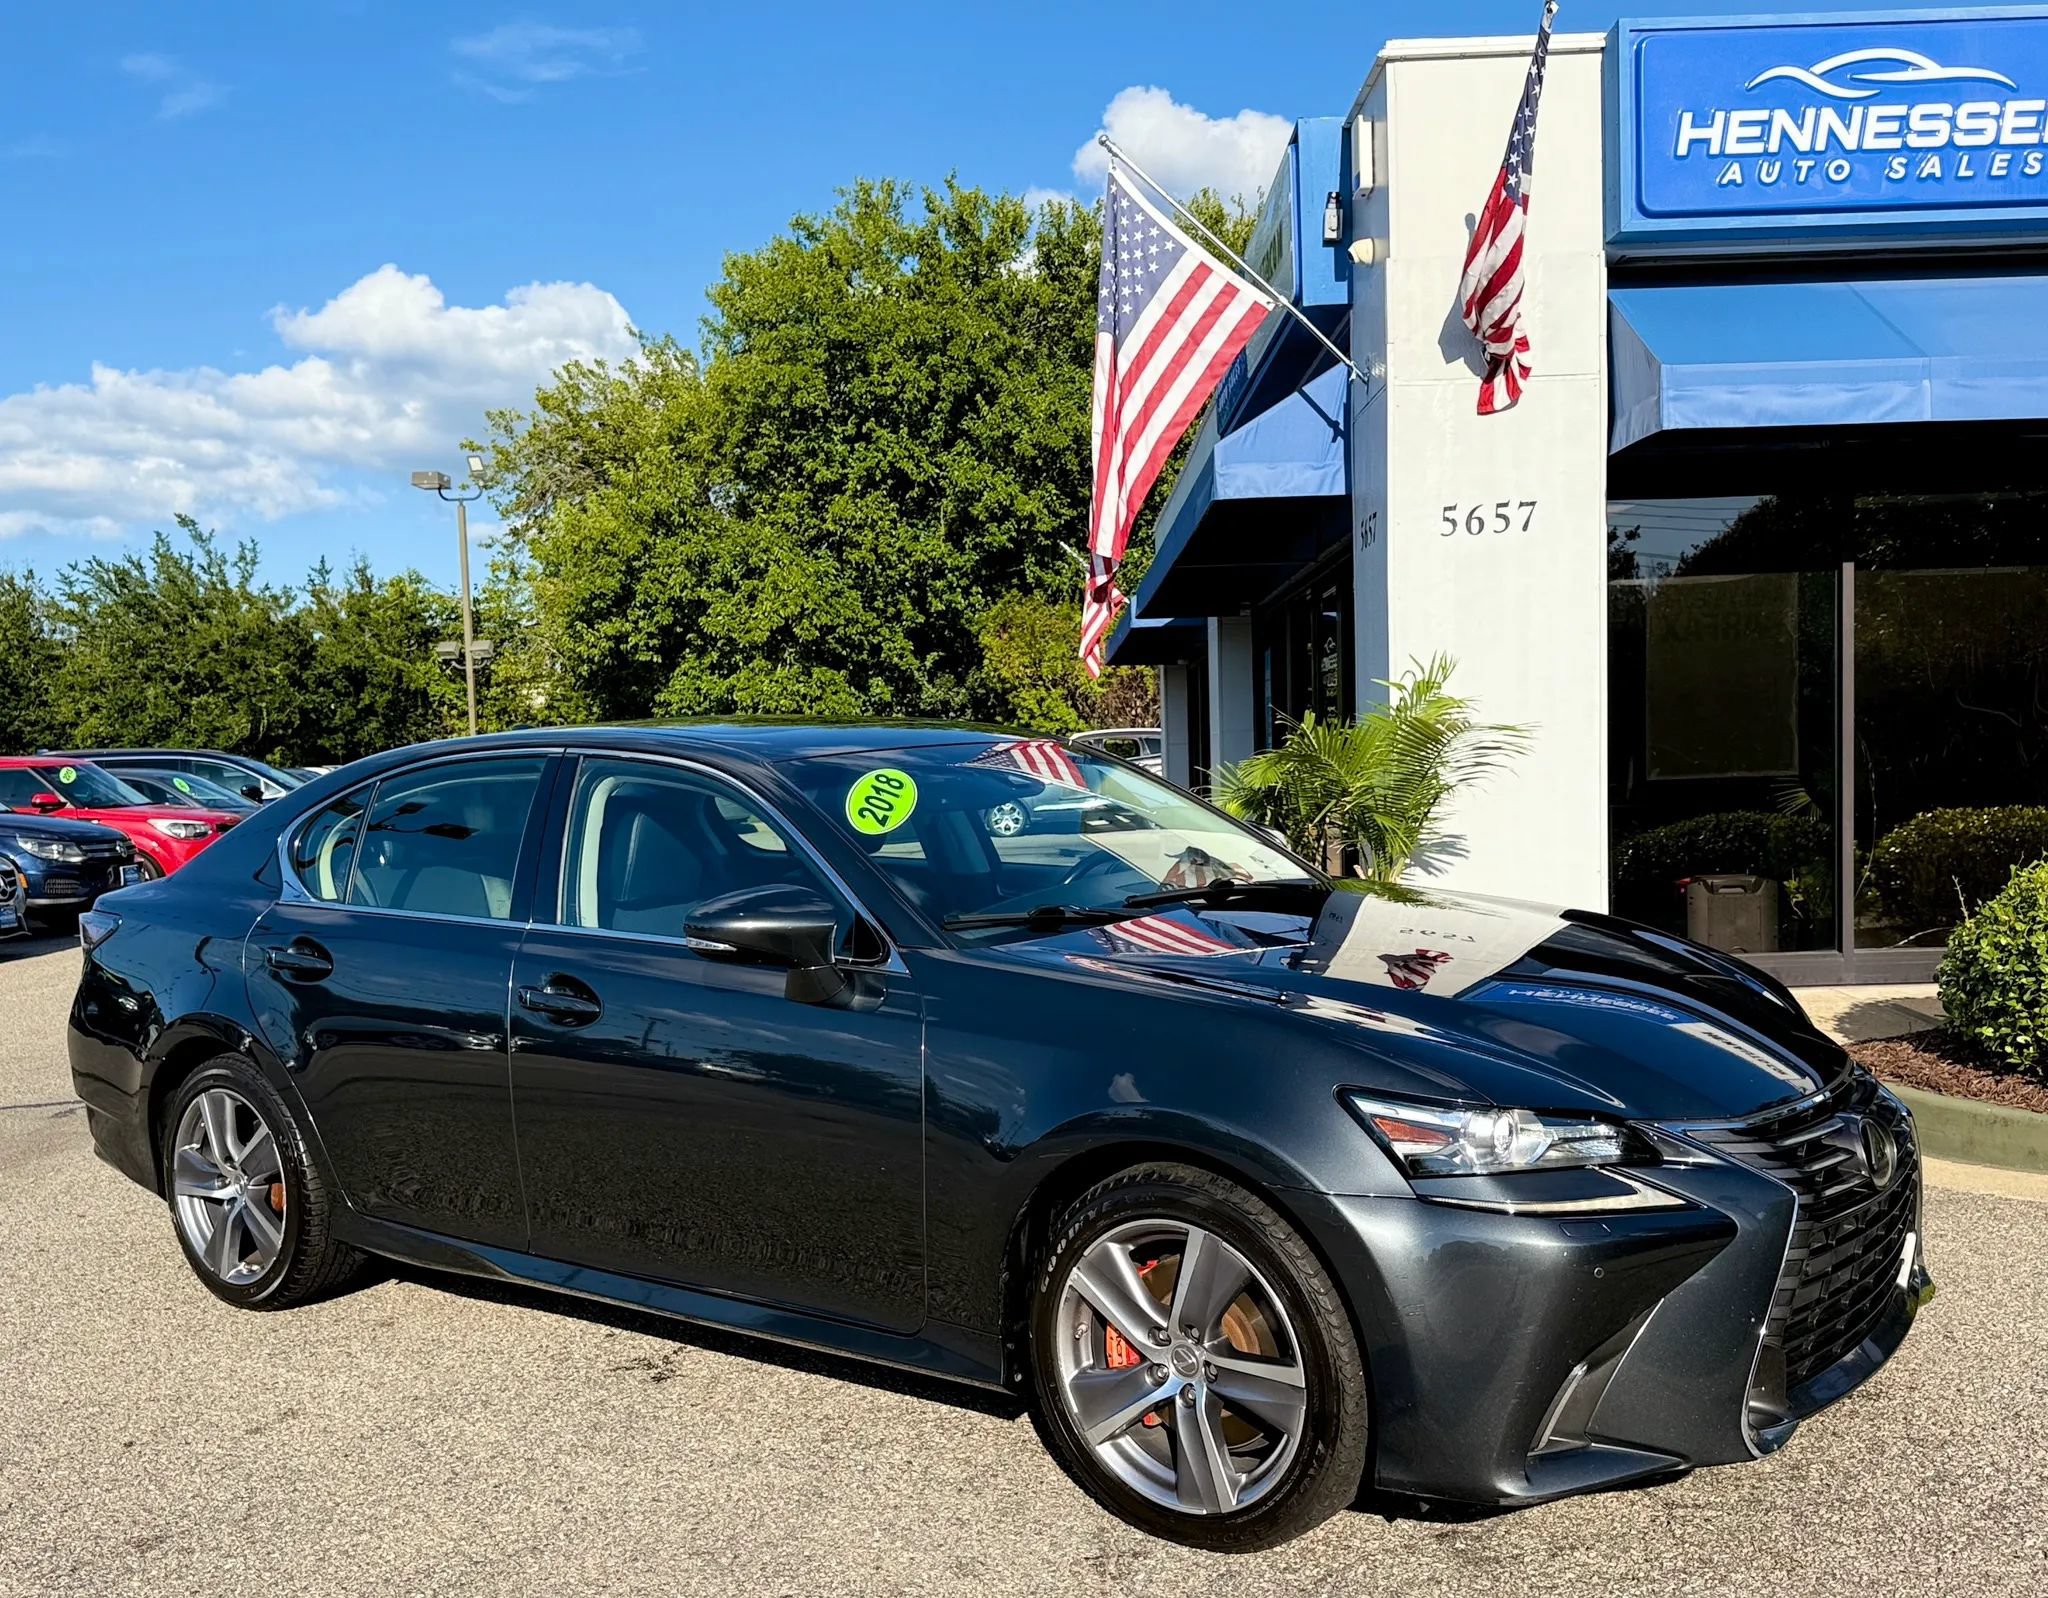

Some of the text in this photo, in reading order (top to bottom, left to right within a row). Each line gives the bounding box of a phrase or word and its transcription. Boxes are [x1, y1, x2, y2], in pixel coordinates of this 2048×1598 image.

[1676, 99, 2048, 157] HENNESSE
[1719, 152, 2044, 185] AUTO SALES
[1360, 511, 1377, 552] 5657
[1440, 499, 1538, 537] 5657
[857, 773, 905, 828] 2018
